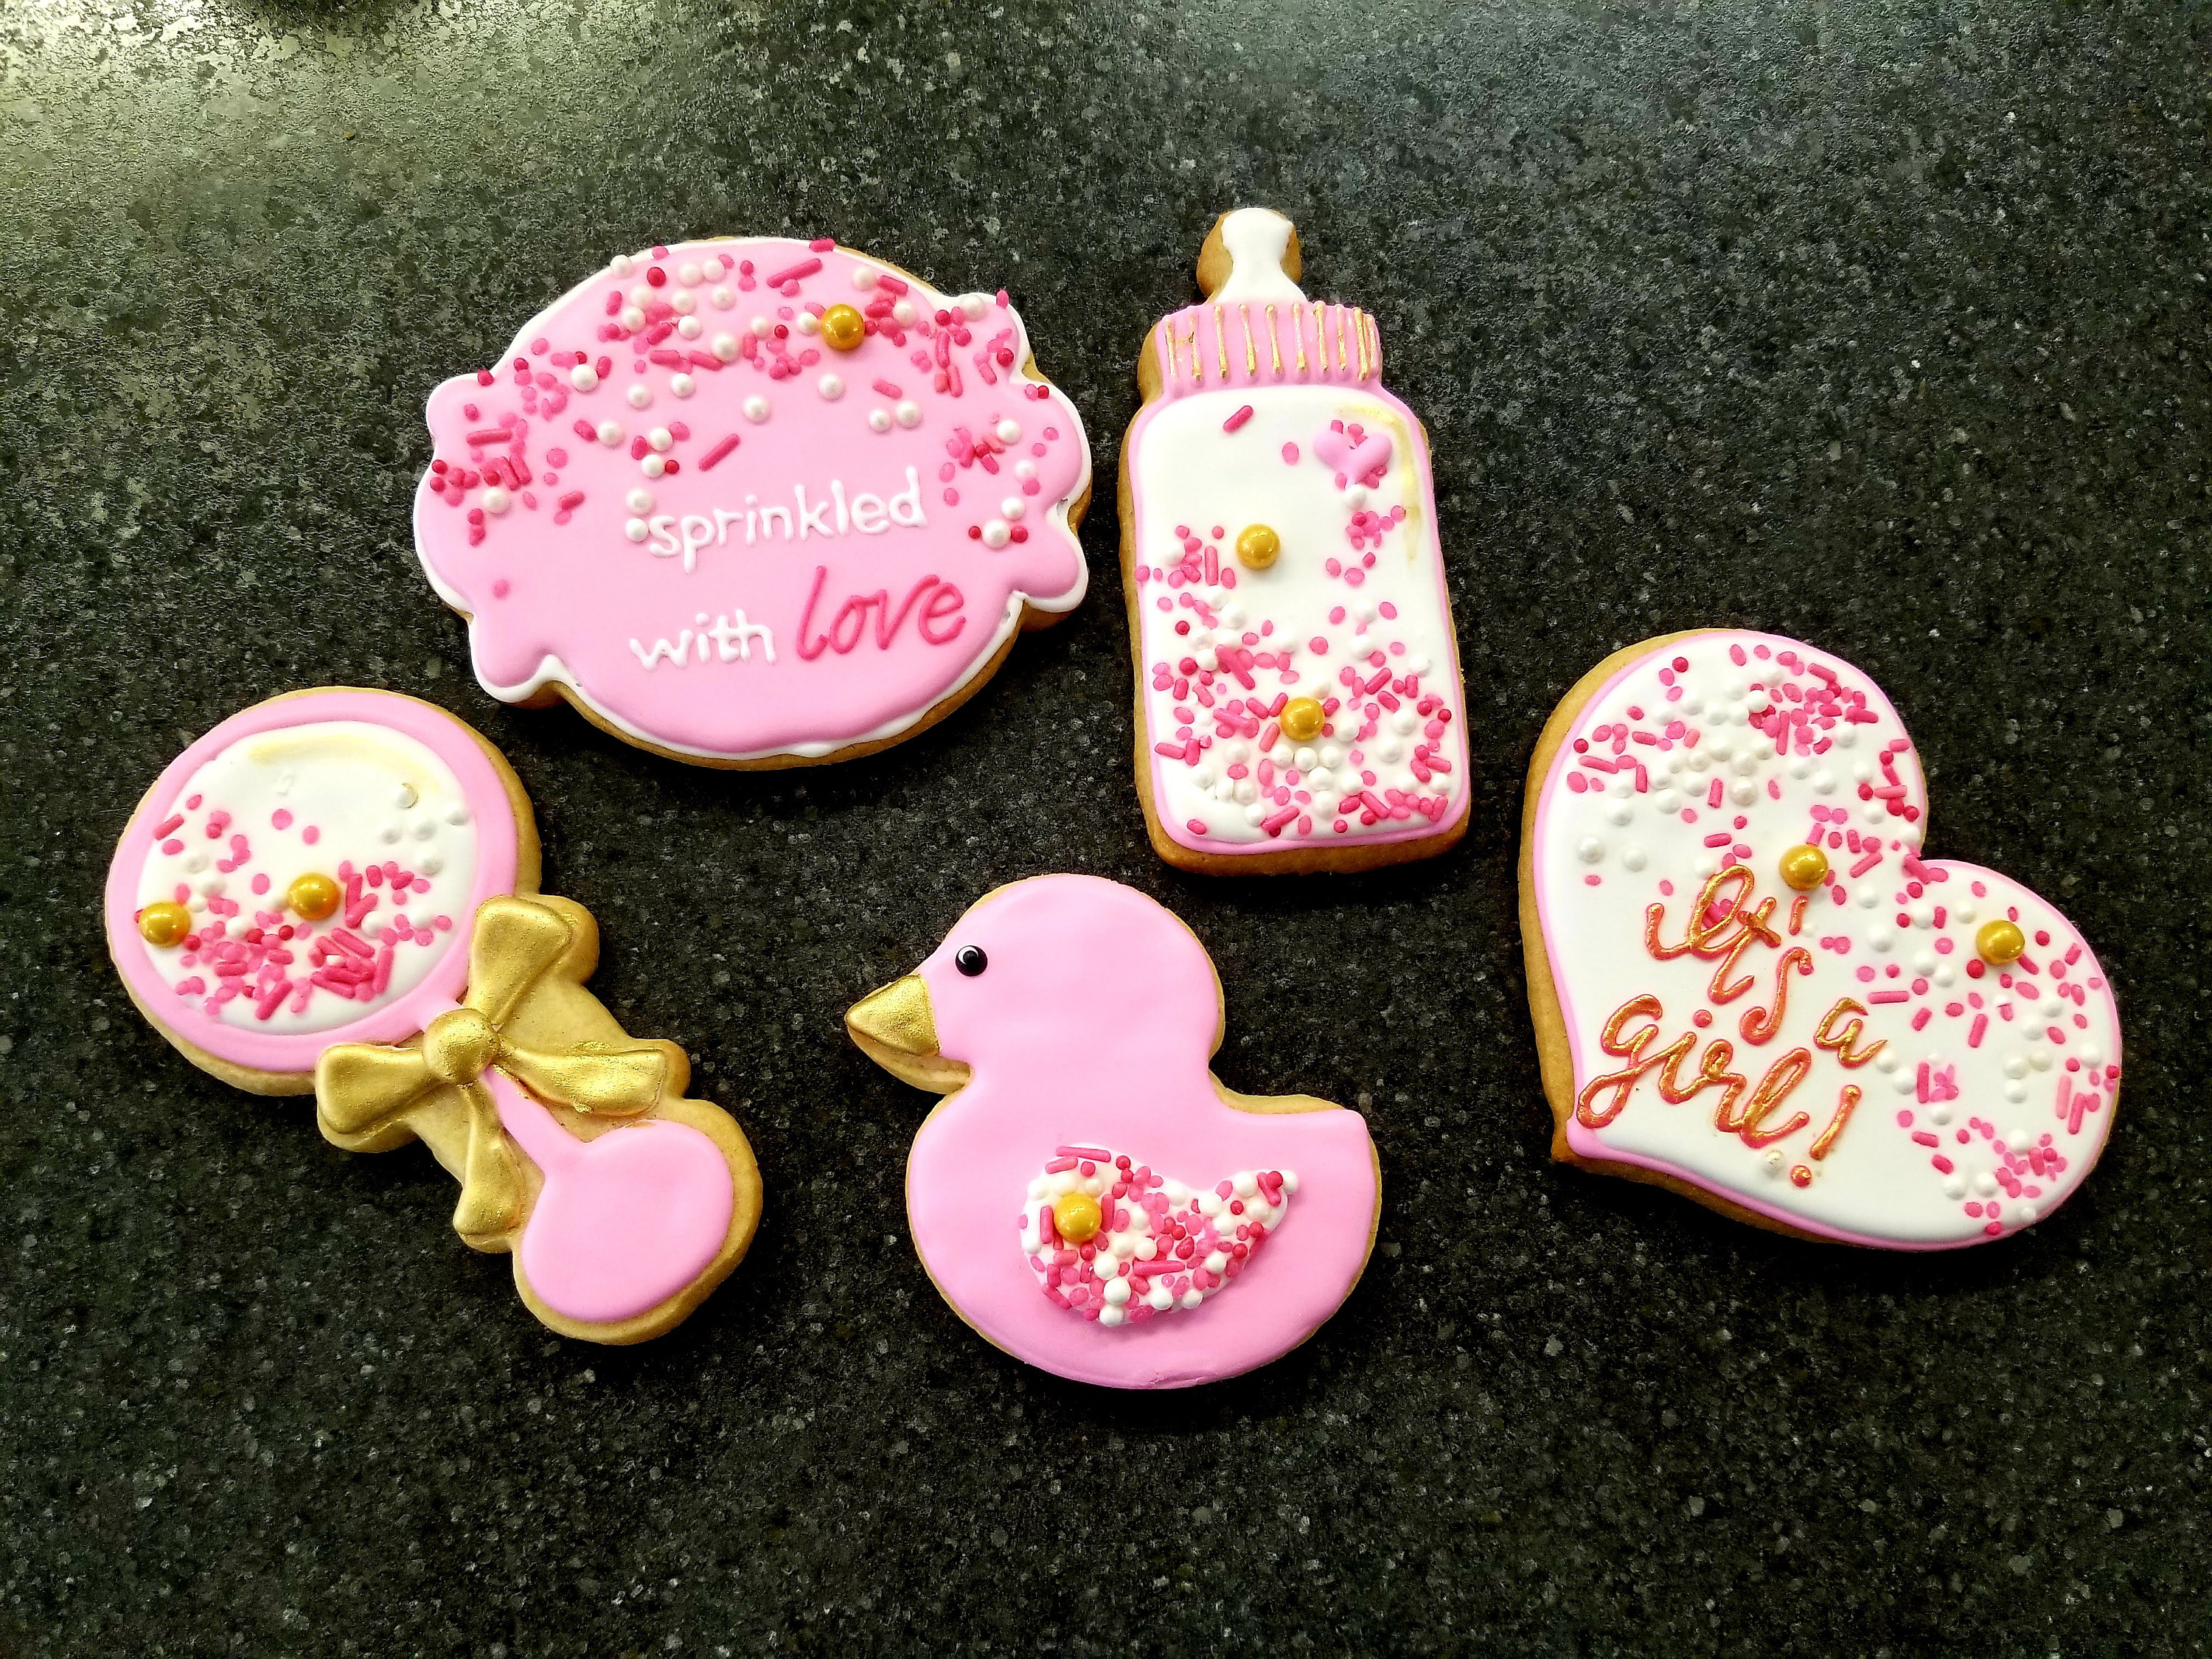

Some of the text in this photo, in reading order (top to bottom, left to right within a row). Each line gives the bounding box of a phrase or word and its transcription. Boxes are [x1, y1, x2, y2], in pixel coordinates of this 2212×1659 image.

[648, 466, 927, 574] sprinkled
[630, 566, 966, 671] with love
[1815, 997, 1888, 1068] a
[1576, 994, 1863, 1189] girl!
